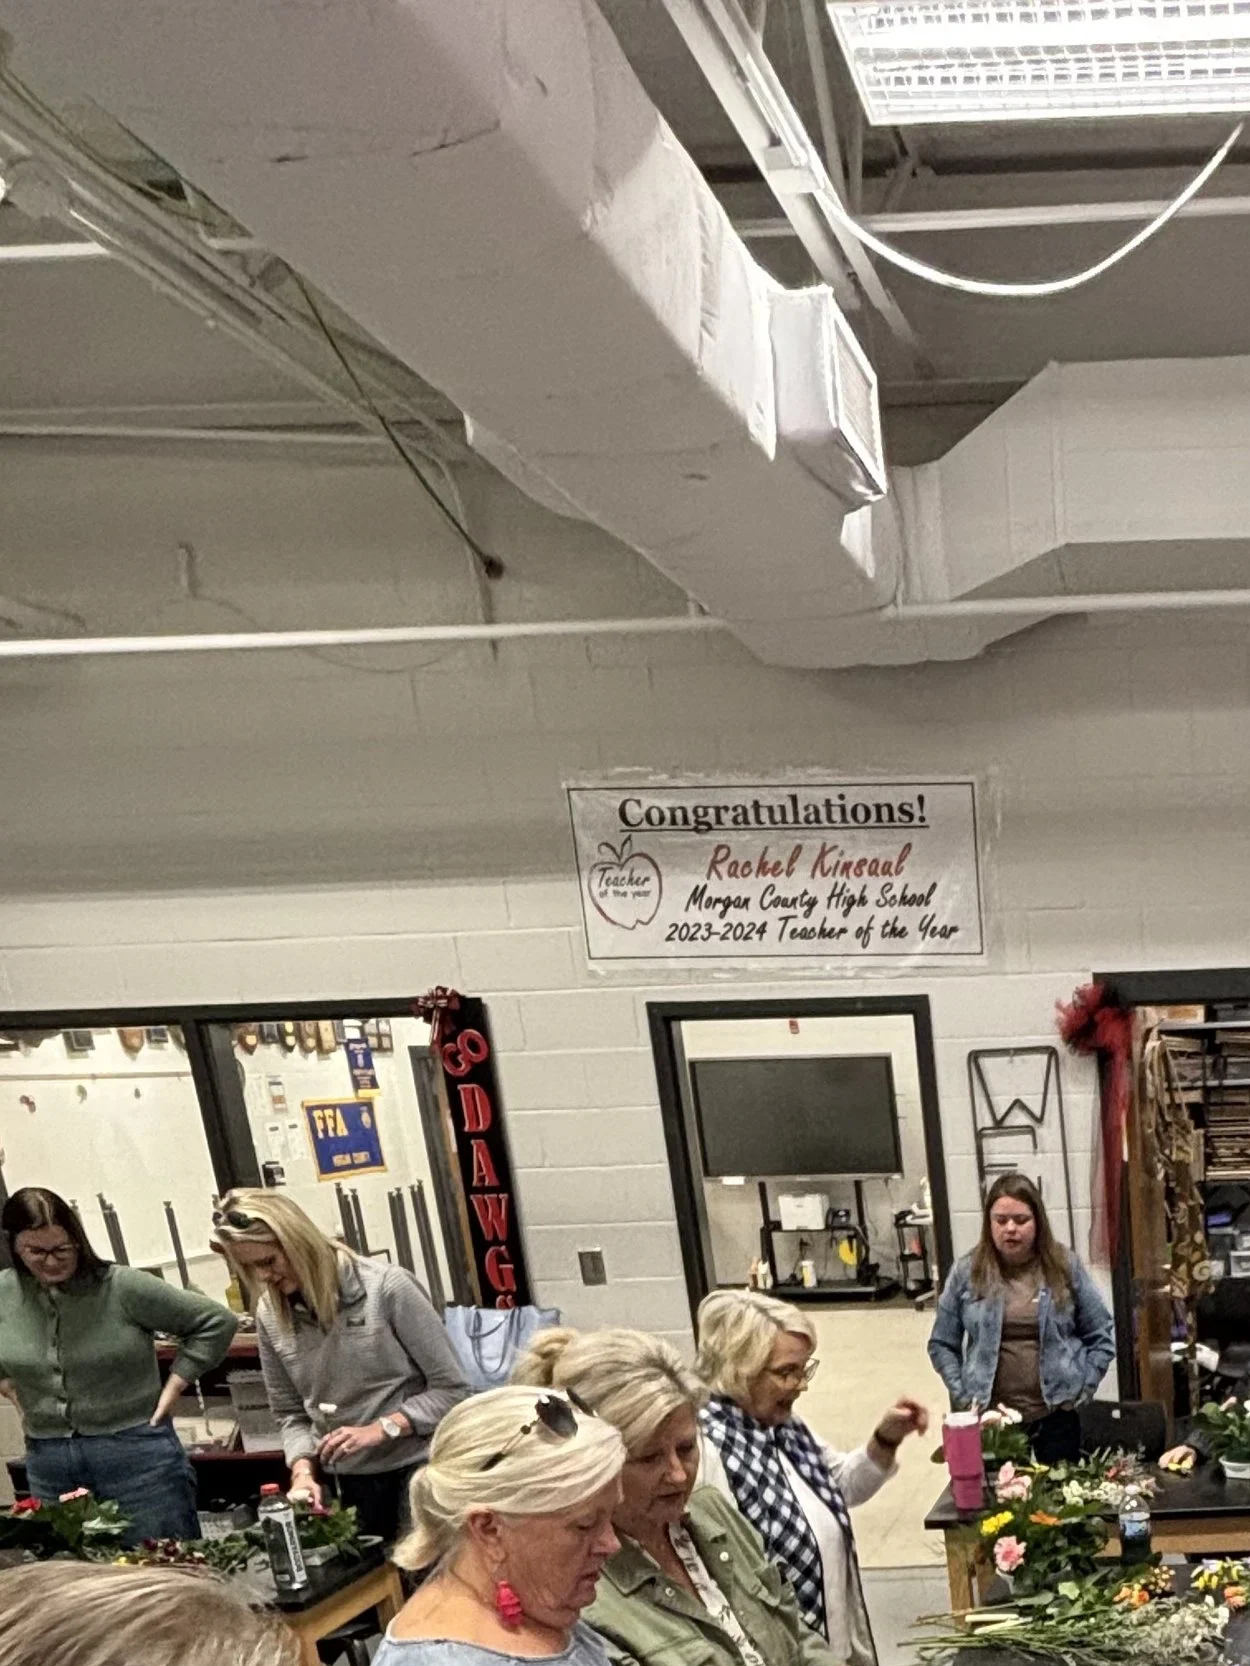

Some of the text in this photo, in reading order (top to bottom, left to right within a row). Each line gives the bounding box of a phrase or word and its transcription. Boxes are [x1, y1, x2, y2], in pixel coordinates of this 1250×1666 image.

[618, 794, 927, 834] Congratulations!
[598, 866, 651, 888] Teacher
[706, 841, 912, 881] Rachel Kinsaul
[684, 880, 938, 919] Morgan County High School
[665, 913, 960, 949] 2023-2024 Teacher of the Year
[312, 1107, 349, 1139] FFA
